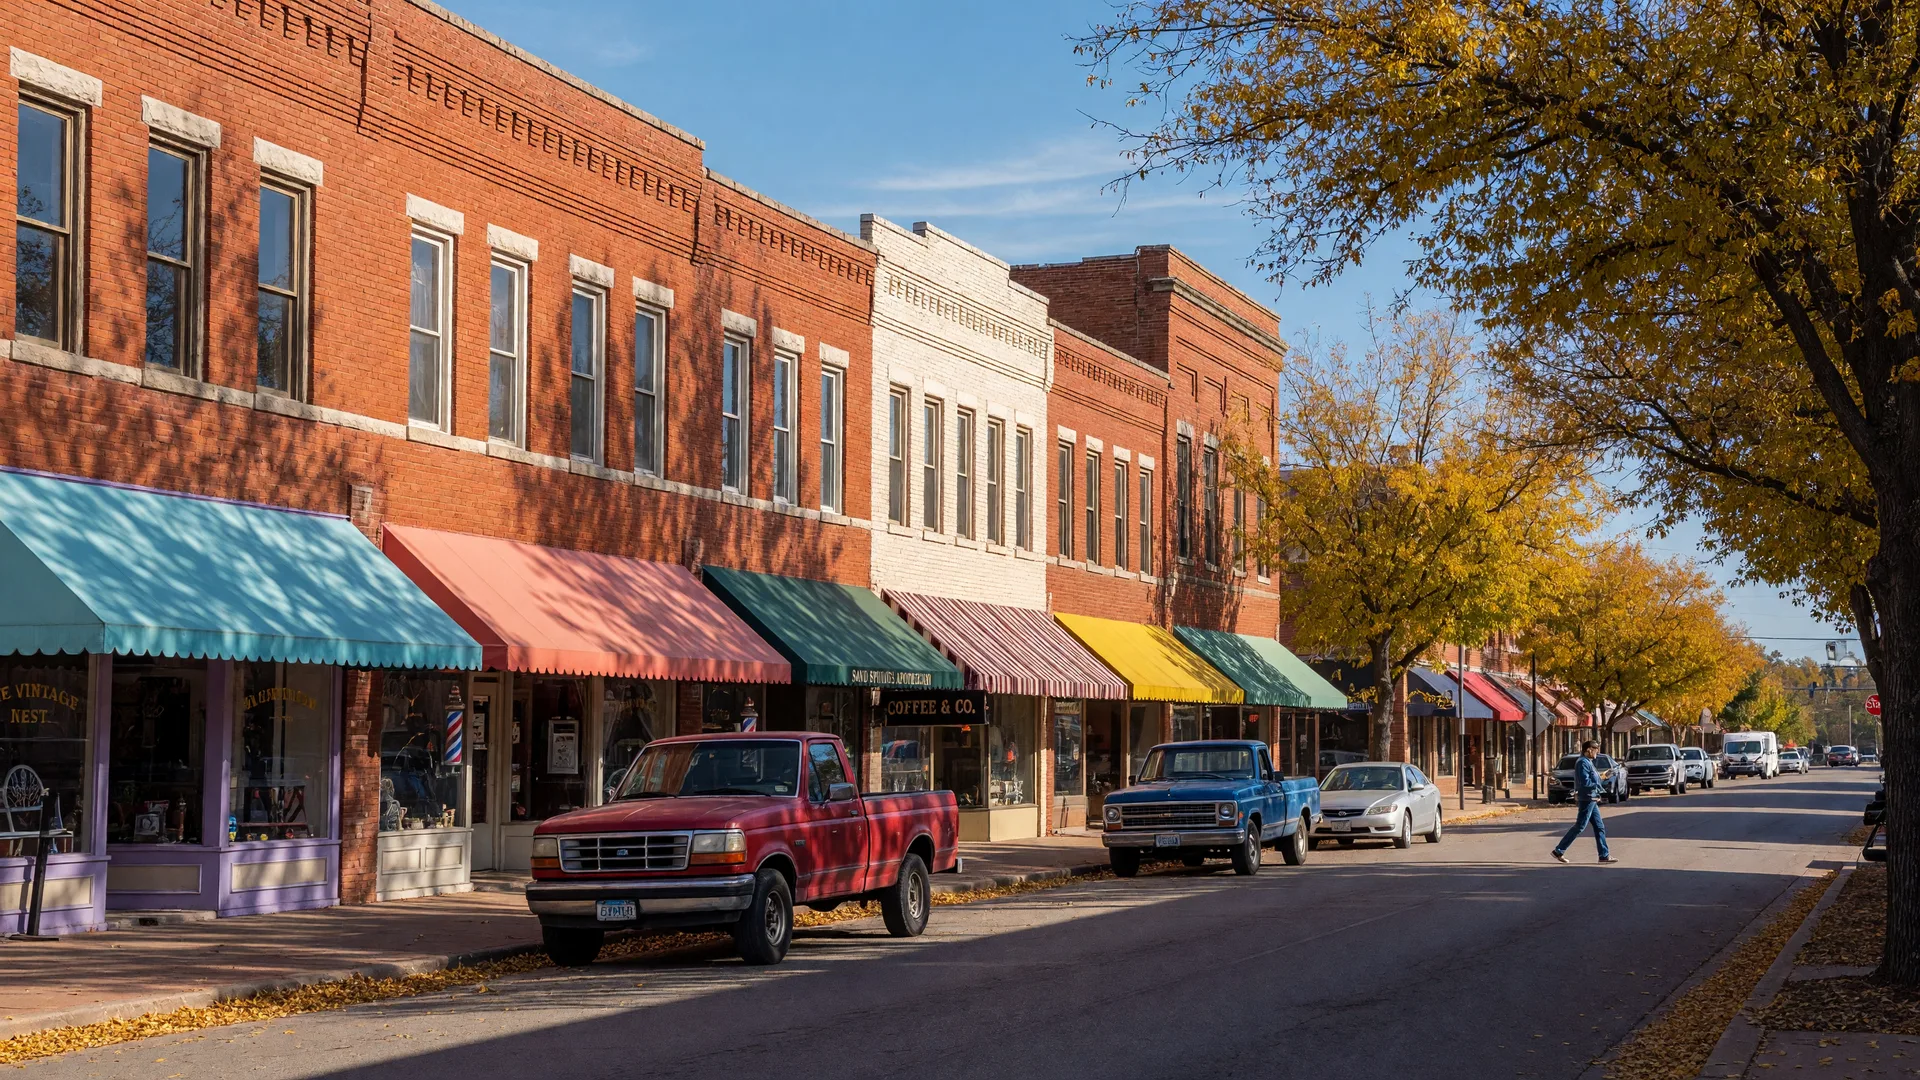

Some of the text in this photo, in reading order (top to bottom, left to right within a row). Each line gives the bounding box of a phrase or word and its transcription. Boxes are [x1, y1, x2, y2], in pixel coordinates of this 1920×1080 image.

[0, 683, 79, 710] E VINTAGE
[888, 699, 976, 715] COFFEE & CO.
[10, 708, 49, 724] NEST
